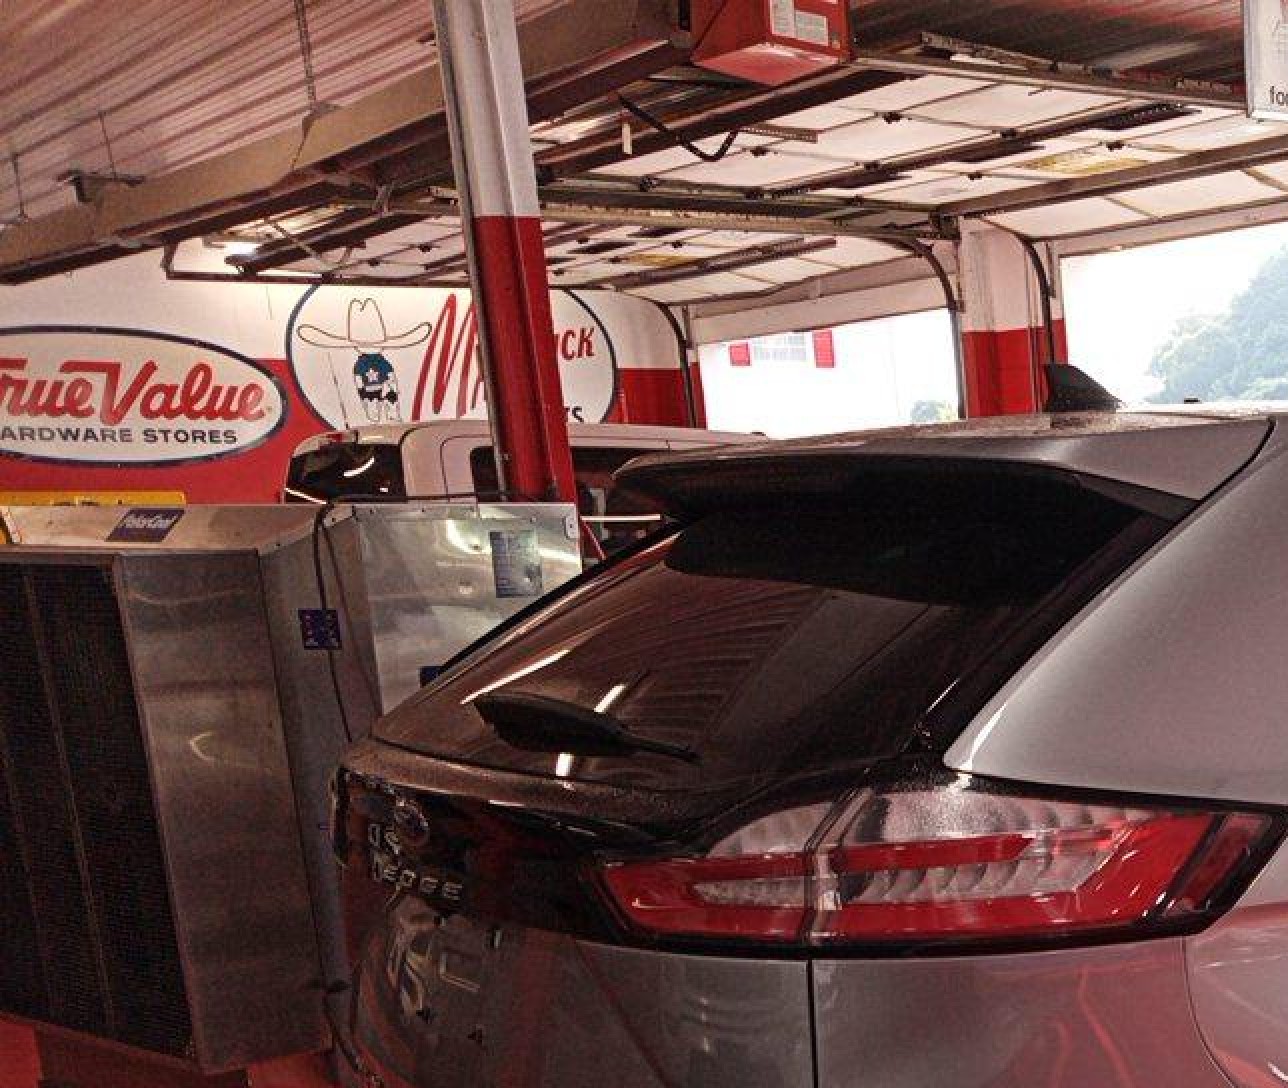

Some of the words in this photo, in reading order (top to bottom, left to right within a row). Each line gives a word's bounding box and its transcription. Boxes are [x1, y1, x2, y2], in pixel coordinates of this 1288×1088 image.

[58, 359, 265, 427] Value
[1, 425, 133, 443] ARDWARE
[142, 428, 238, 445] STORES
